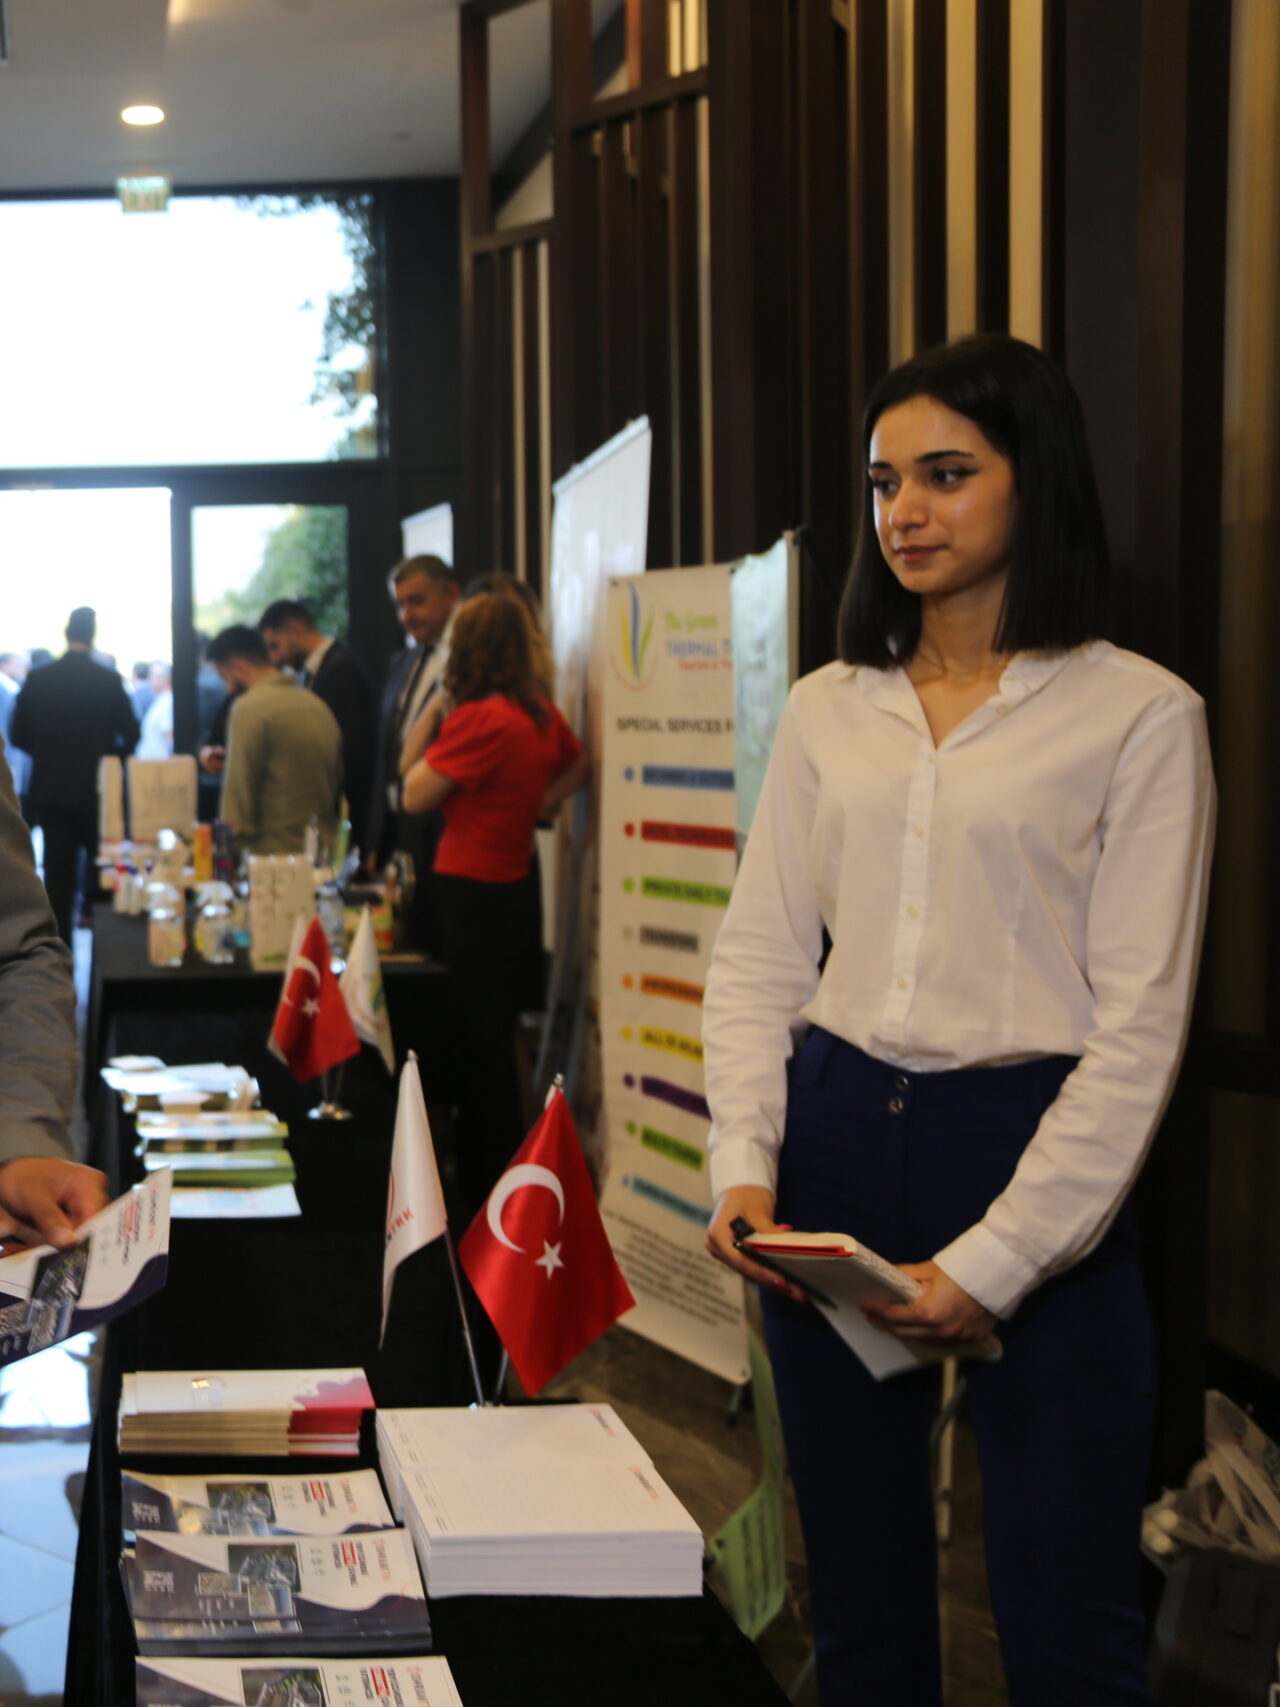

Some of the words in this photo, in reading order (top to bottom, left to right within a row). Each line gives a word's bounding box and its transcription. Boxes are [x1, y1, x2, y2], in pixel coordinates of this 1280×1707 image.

[665, 639, 719, 657] THERMAL
[616, 717, 663, 732] SPECIAL
[666, 718, 722, 734] SERVICES
